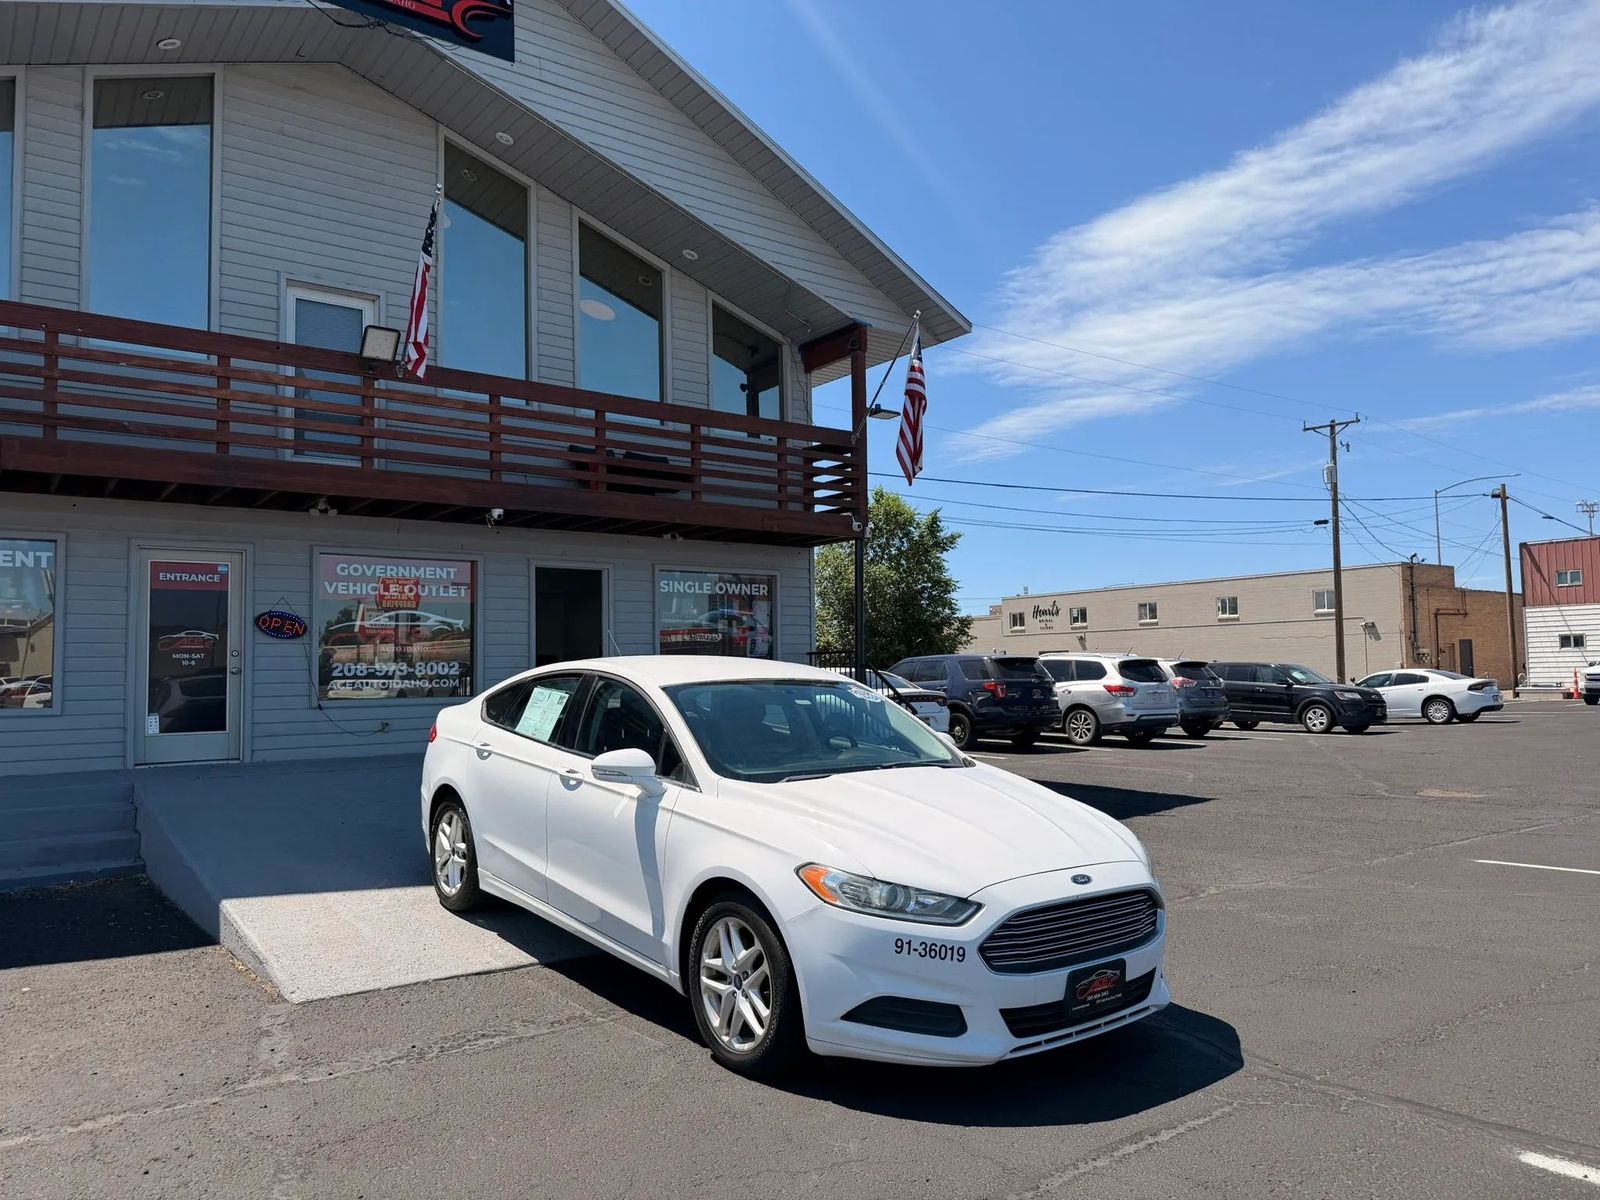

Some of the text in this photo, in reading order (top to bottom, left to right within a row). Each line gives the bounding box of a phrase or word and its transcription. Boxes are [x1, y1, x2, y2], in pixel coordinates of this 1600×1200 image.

[159, 572, 221, 583] ENTRANCE
[336, 563, 457, 579] GOVERNMENT
[324, 581, 399, 595] VEHICLE
[404, 584, 468, 598] OUTLET
[660, 580, 768, 596] SINGLE OWNER
[259, 616, 305, 635] OPEN
[327, 678, 460, 690] ACEAUTOIDAHO.COM
[894, 937, 966, 963] 91-36019
